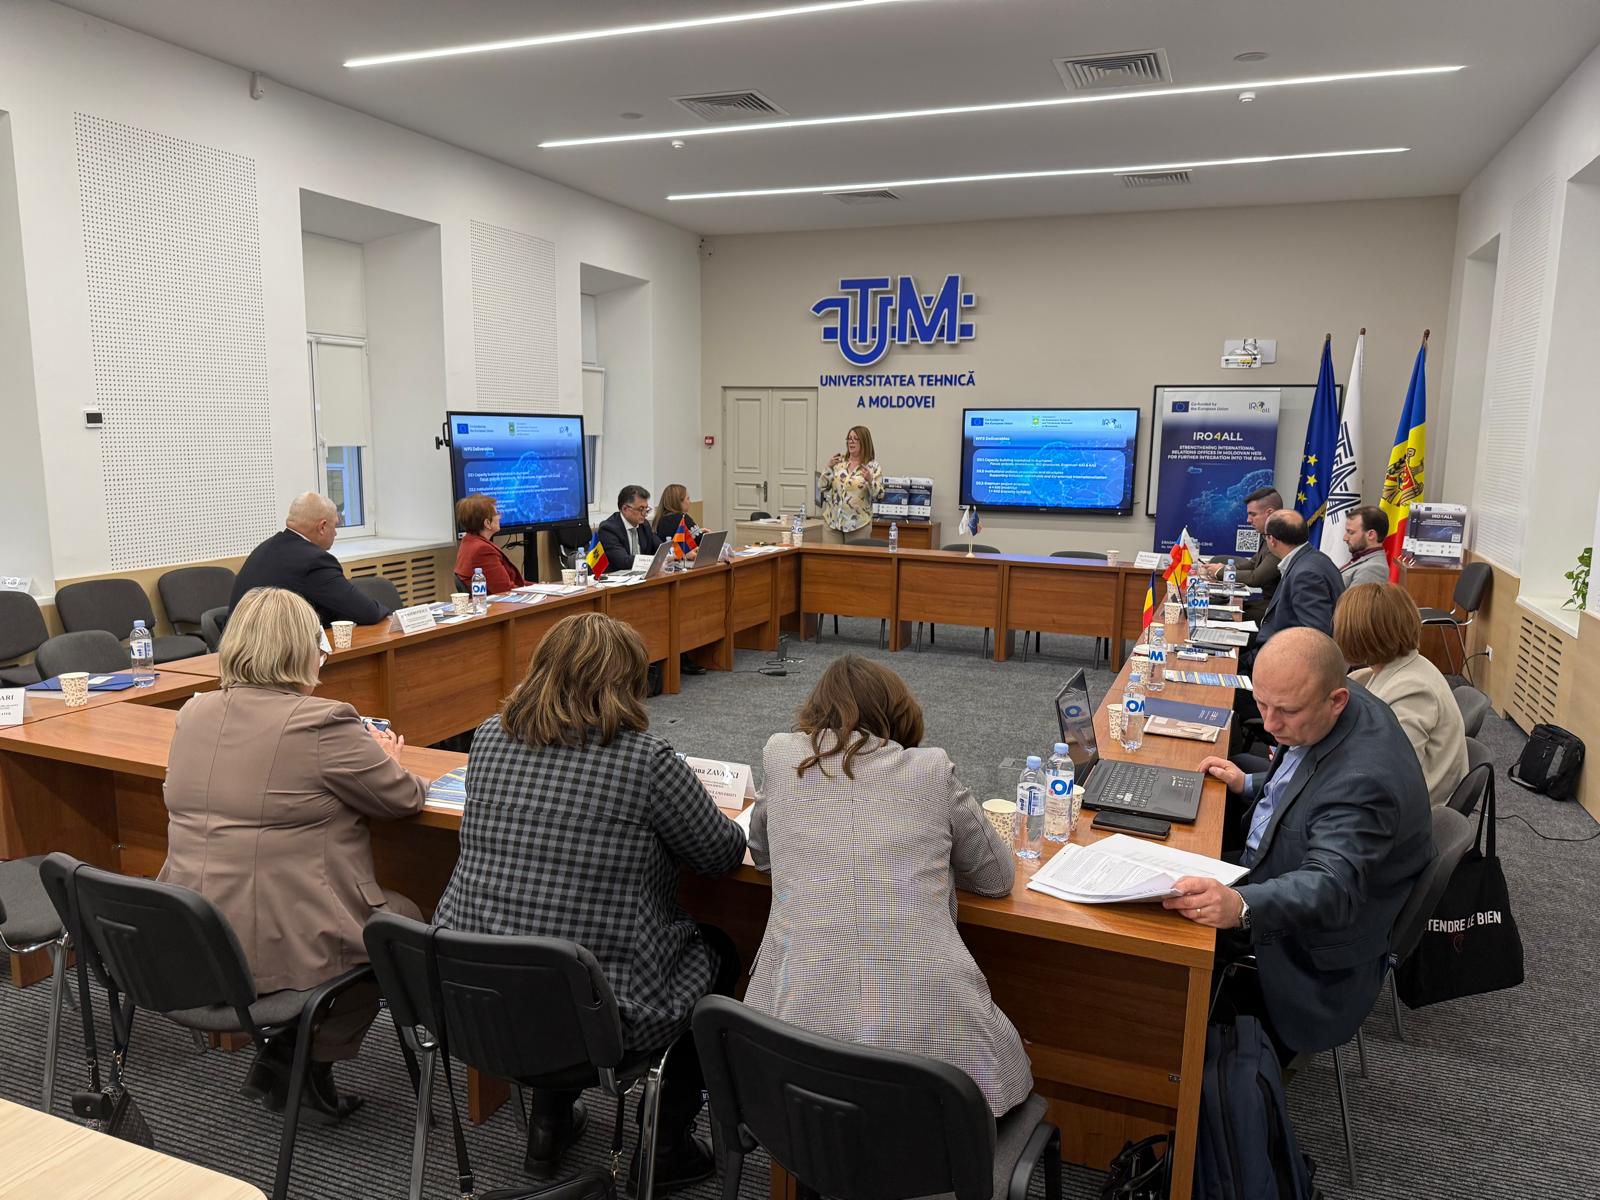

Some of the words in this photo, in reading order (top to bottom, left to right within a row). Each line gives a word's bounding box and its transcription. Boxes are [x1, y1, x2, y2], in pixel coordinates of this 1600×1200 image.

[820, 374, 916, 387] UNIVERSITATEA
[918, 370, 976, 387] TEHNICĂ
[856, 395, 866, 409] A
[868, 395, 935, 409] MOLDOVEI
[1193, 432, 1244, 441] IRO4ALL
[1424, 918, 1466, 933] TENDRE
[1466, 914, 1475, 929] LE
[1476, 910, 1502, 925] BIEN
